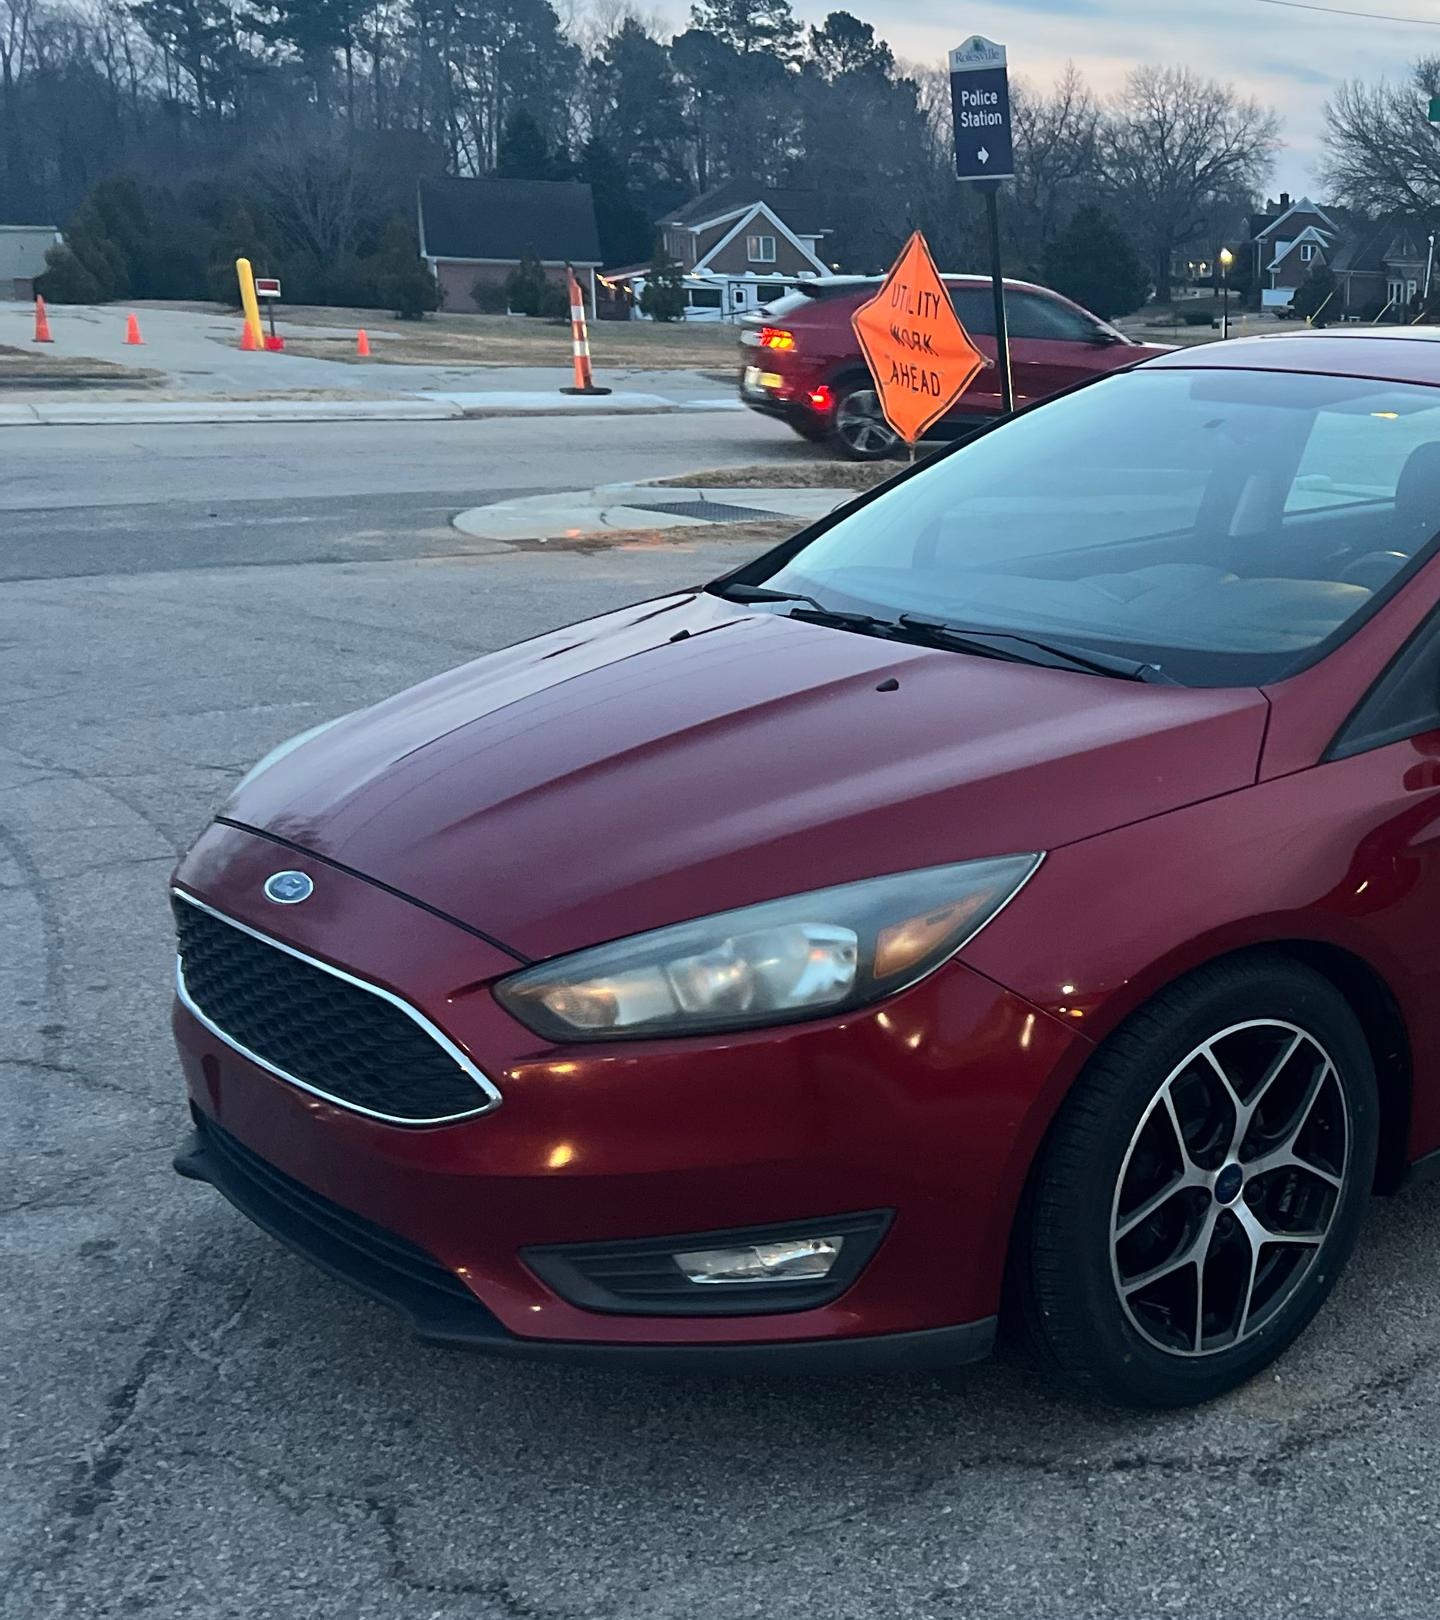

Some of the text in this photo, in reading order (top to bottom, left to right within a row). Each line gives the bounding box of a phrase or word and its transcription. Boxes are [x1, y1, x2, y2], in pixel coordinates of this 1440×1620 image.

[961, 89, 998, 107] Police
[960, 109, 1002, 127] Station
[891, 282, 940, 320] UTILITY
[890, 323, 939, 356] WORK
[890, 361, 940, 396] AHEAD
